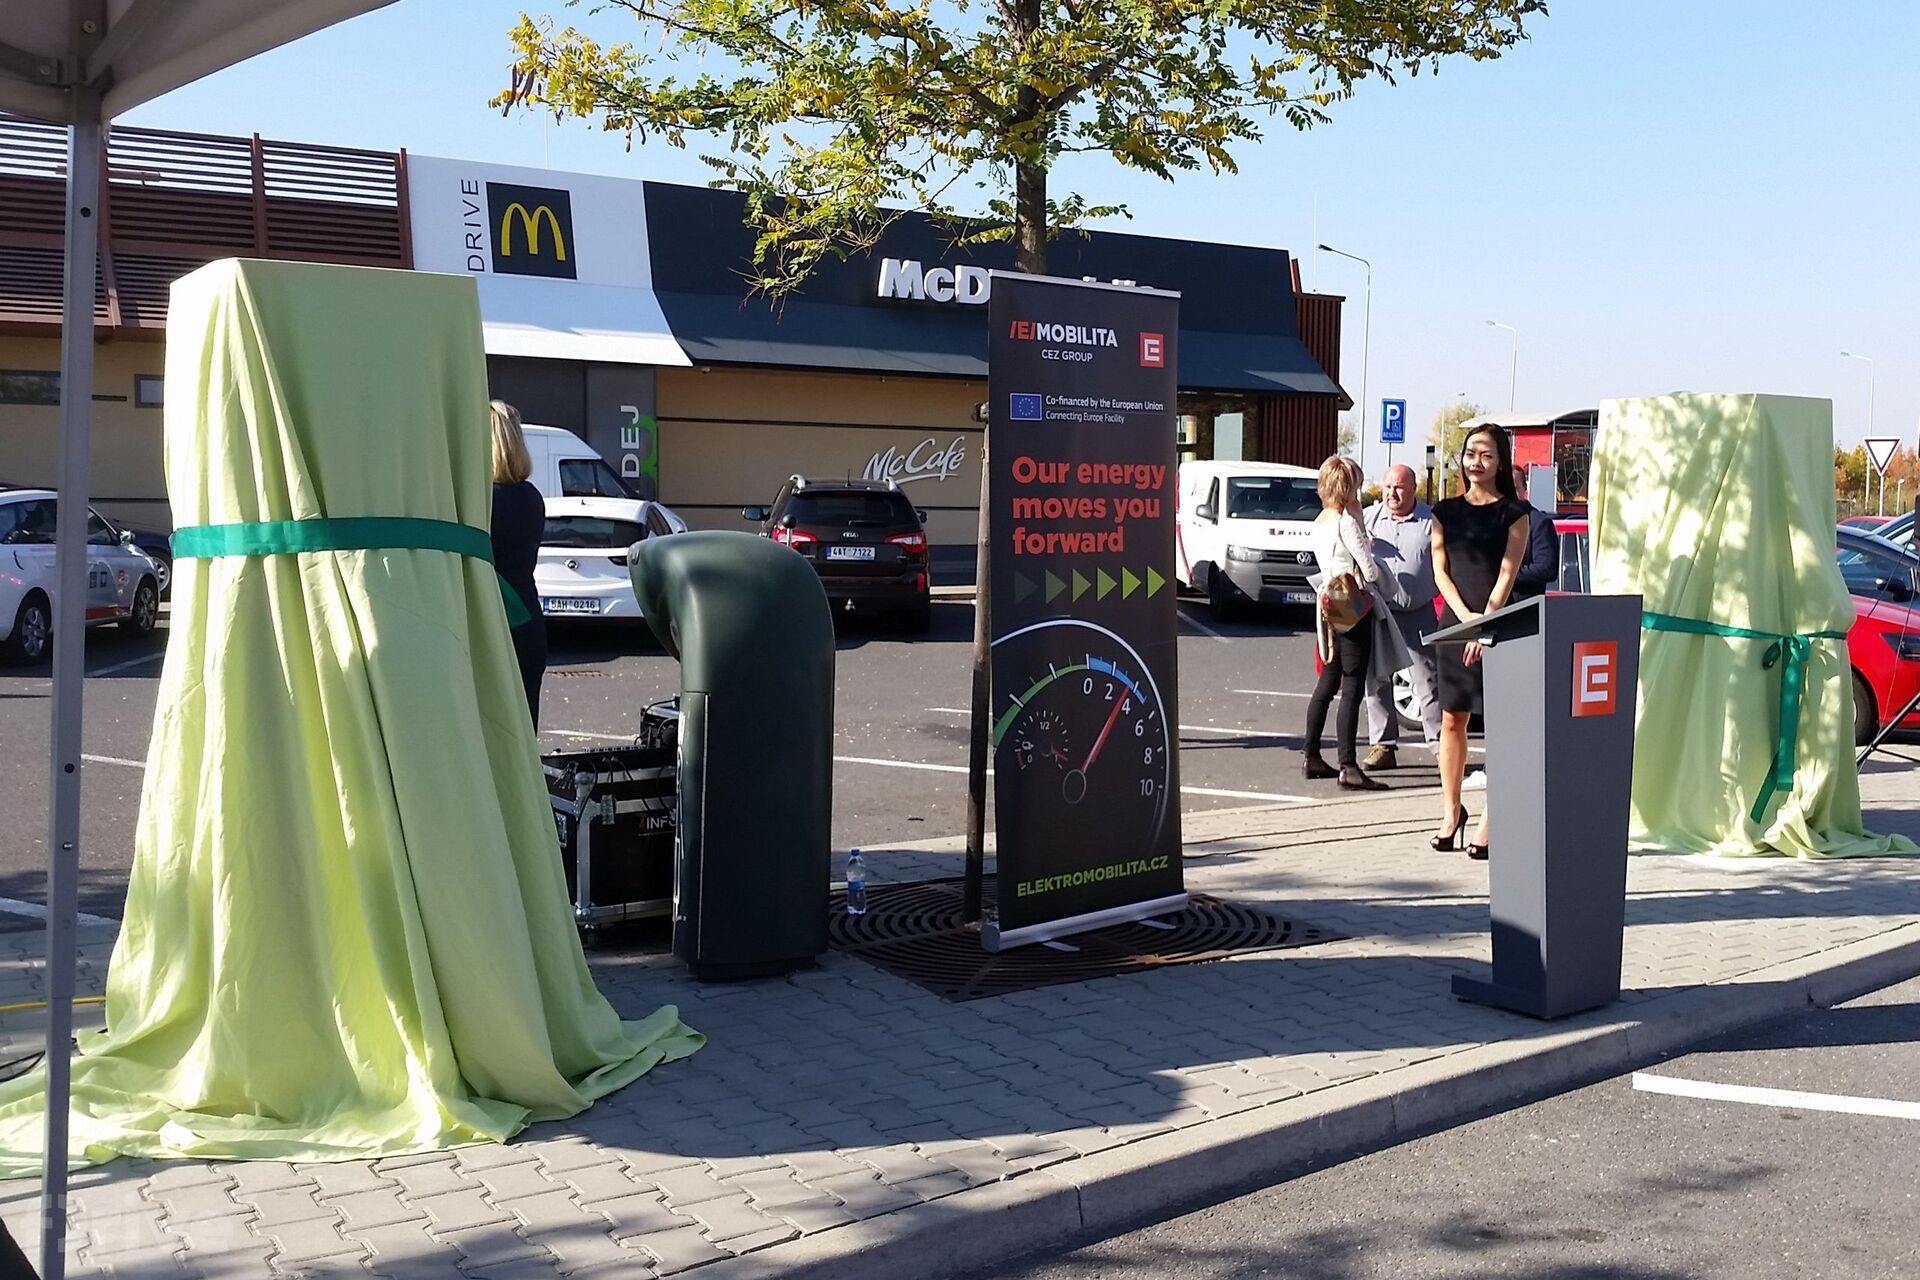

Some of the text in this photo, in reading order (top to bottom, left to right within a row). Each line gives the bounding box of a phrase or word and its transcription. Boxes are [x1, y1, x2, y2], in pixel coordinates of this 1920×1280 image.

[461, 179, 485, 272] DRIVE
[1061, 350, 1093, 363] GROUP
[1045, 395, 1164, 411] Co-financed by the European Union
[1045, 411, 1125, 425] Connecting Europe Facility
[1386, 404, 1401, 430] P
[620, 405, 640, 478] DEJ
[1012, 456, 1070, 483] Our
[1077, 463, 1166, 490] energy
[1012, 497, 1160, 523] moves you
[1012, 526, 1124, 554] forward
[852, 548, 872, 558] 7122
[1083, 678, 1093, 695] 0
[1104, 683, 1114, 700] 2
[1121, 698, 1131, 715] 4
[1135, 719, 1144, 736] 6
[1143, 747, 1153, 765] 8
[1140, 779, 1154, 797] 10
[1017, 855, 1169, 897] ELEKTROMOBILITA.CZ
